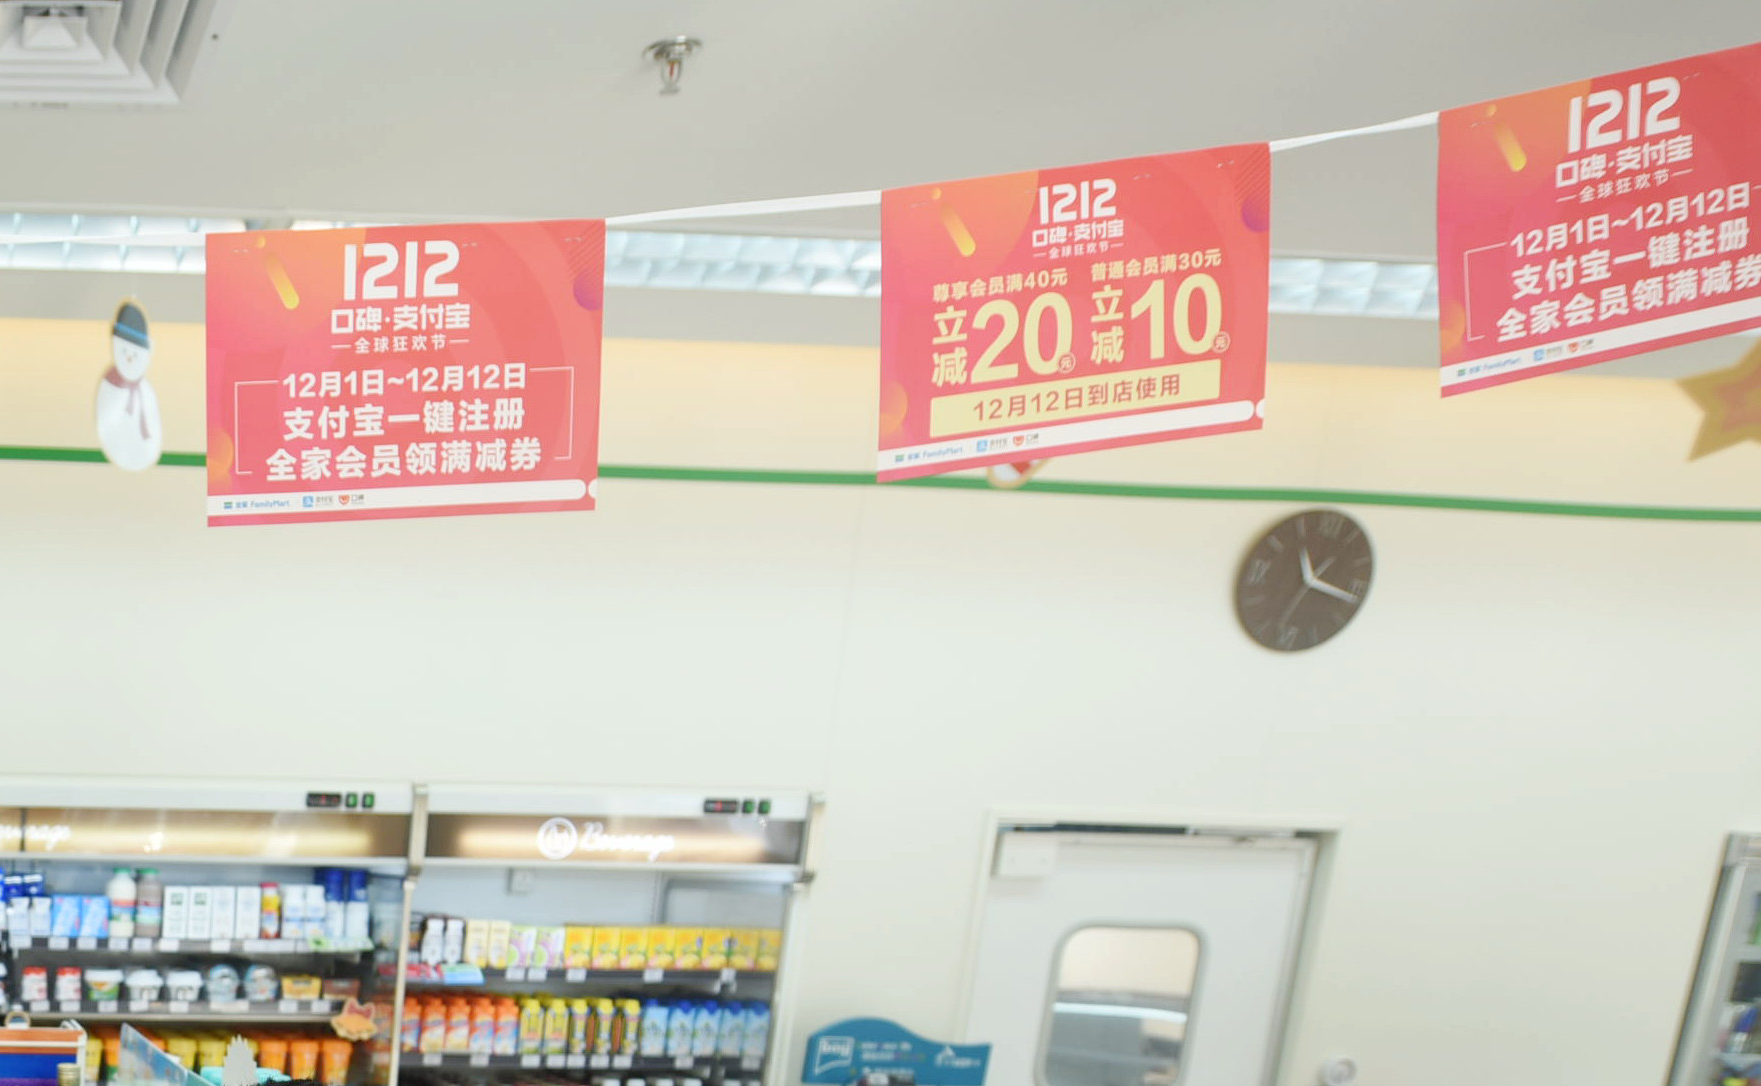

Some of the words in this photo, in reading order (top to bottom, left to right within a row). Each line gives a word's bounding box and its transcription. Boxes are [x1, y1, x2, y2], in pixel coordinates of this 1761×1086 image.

[1568, 77, 1681, 153] 1212
[1555, 135, 1693, 188] 口碑·支付宝
[1038, 178, 1117, 224] 1212
[1579, 169, 1670, 204] 全球狂欢节
[1032, 220, 1124, 248] 口碑·支付宝
[1510, 182, 1750, 258] 12月1日~12月12日
[344, 240, 460, 301] 1212
[1048, 242, 1110, 260] 全球狂欢节
[1091, 248, 1222, 280] 普通会员满30元
[1512, 216, 1750, 300] 支付宝一键注册
[932, 267, 1068, 303] 尊享会员满40元
[1497, 255, 1761, 343] 全家会员领满减券
[331, 303, 470, 334] 口碑·支付宝
[932, 306, 968, 387] 立减
[971, 292, 1073, 384] 20
[1090, 285, 1124, 364] 立减
[1130, 273, 1222, 360] 10
[355, 334, 447, 354] 全球狂欢节
[282, 363, 526, 398] 12月1日~12月12日
[973, 375, 1181, 422] 12月12日到店使用
[283, 398, 525, 441] 支付宝一键注册
[266, 437, 542, 482] 全家会员领满减券
